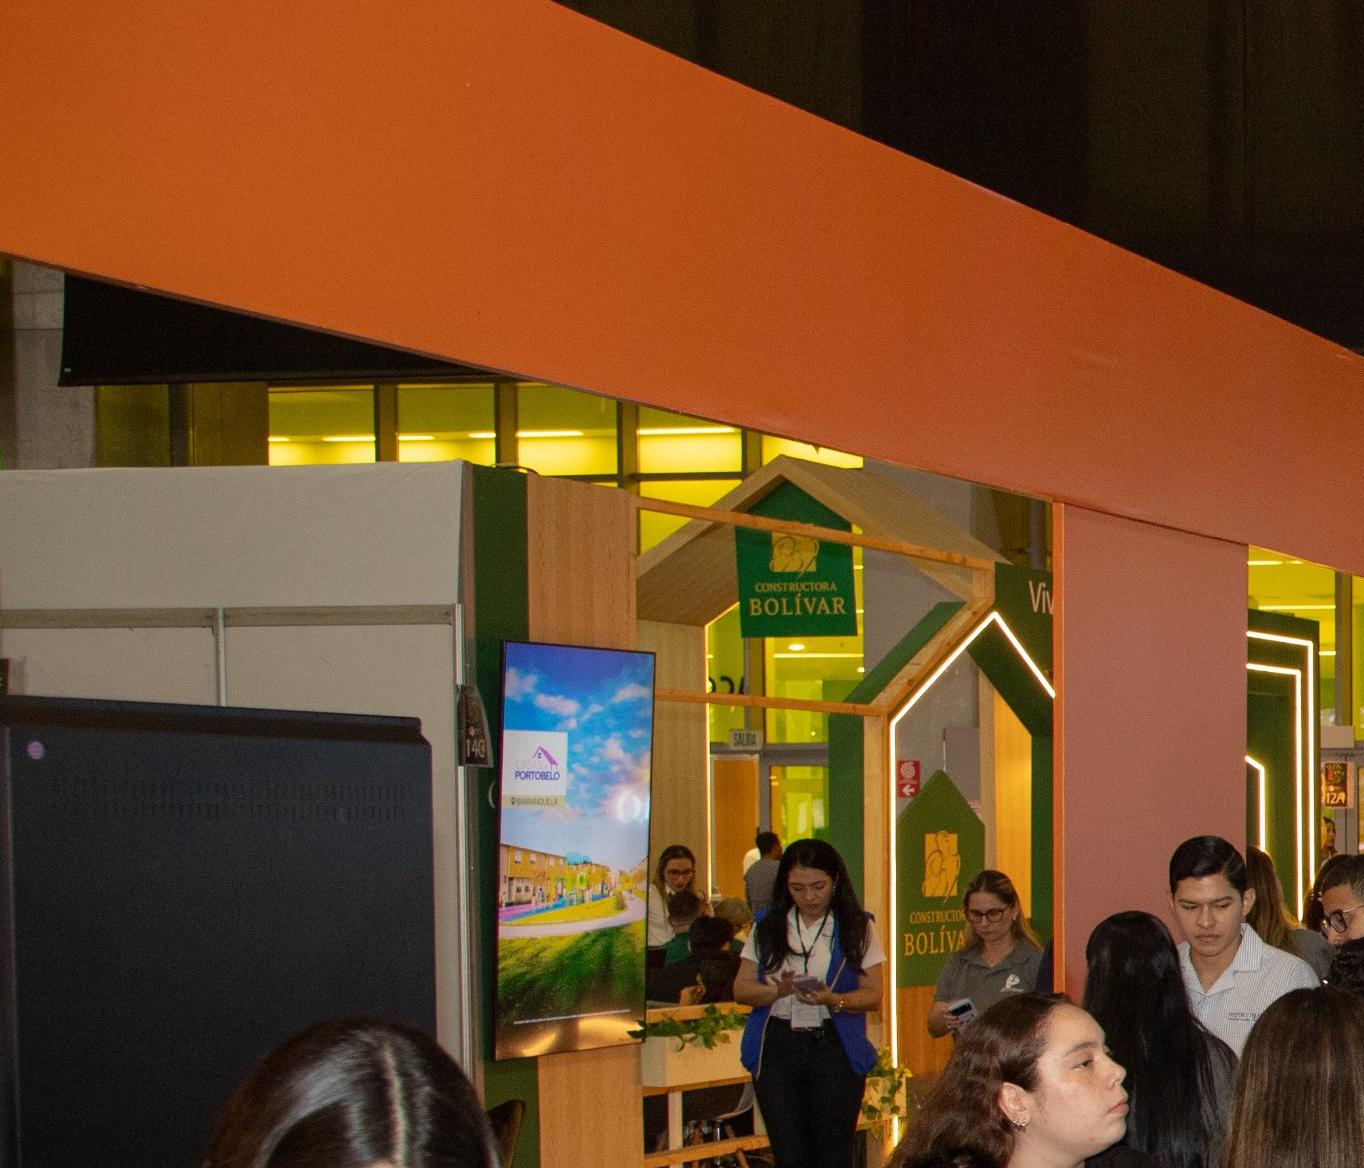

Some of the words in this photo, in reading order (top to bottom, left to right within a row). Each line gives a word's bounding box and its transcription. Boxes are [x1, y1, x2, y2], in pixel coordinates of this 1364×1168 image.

[755, 581, 838, 593] CONSTRUCTORA
[750, 592, 847, 616] BOLÍVAR
[514, 770, 561, 782] PORTOBELO
[910, 910, 966, 925] CONSTRUCTOR
[904, 924, 966, 957] BOLÍVA
